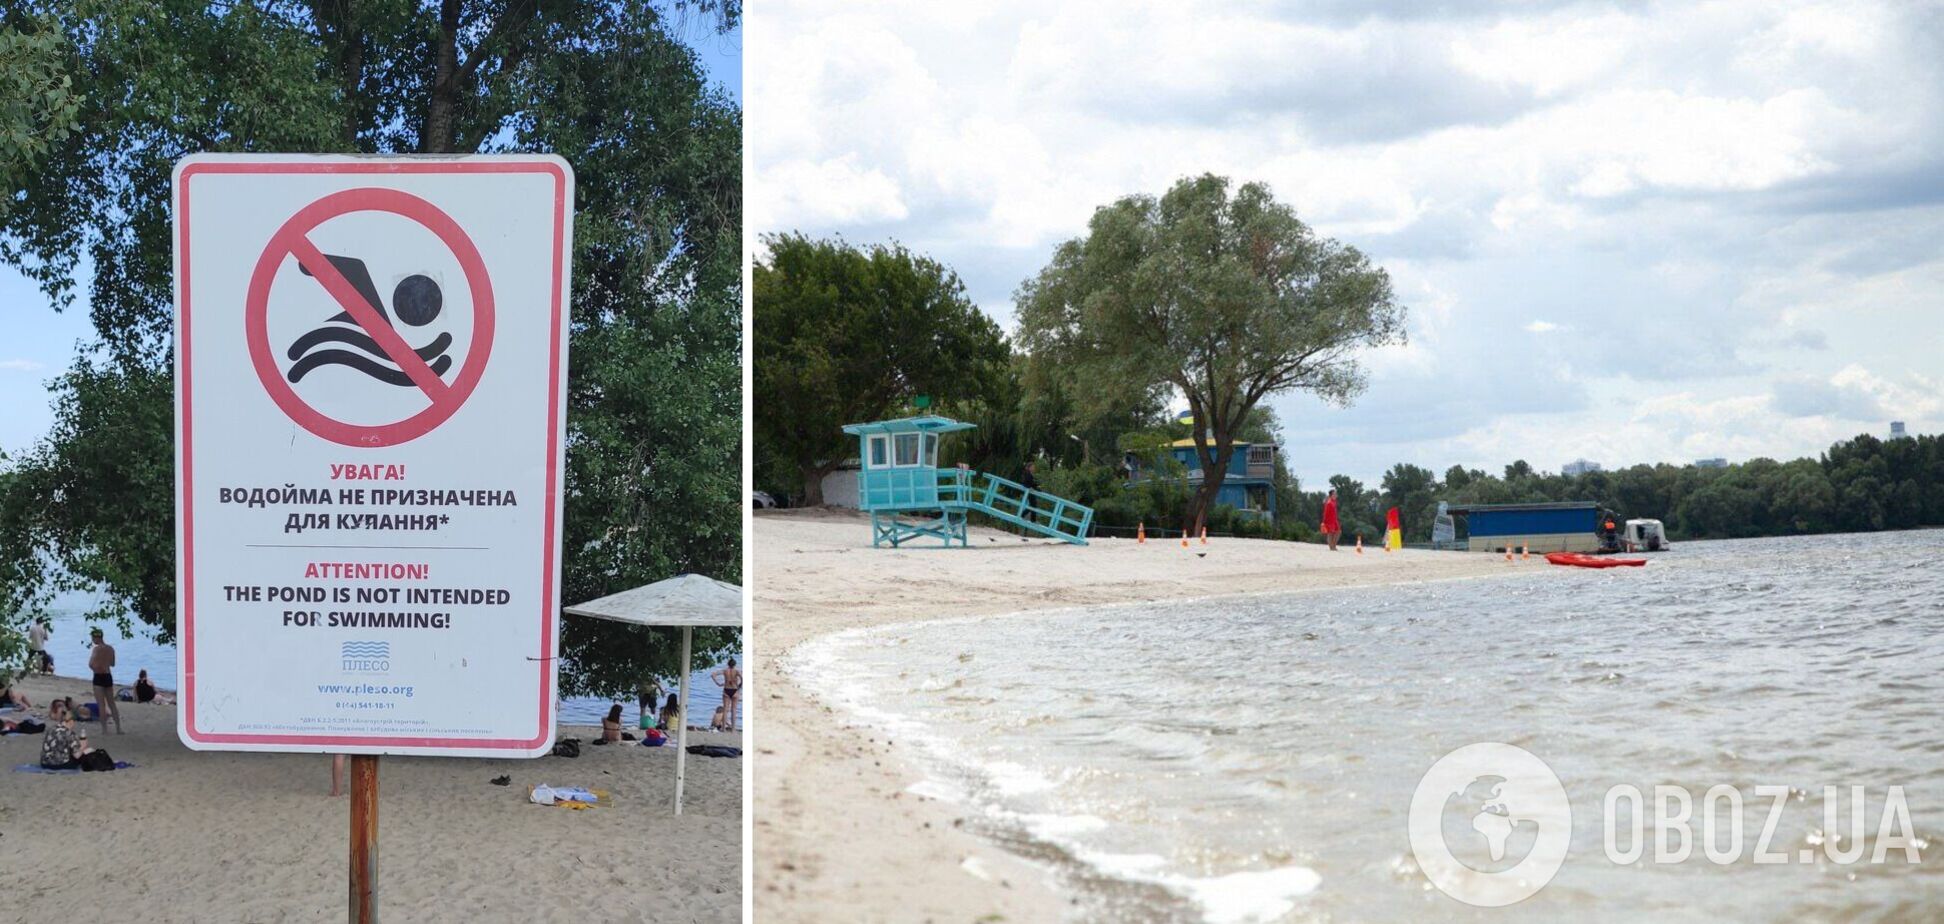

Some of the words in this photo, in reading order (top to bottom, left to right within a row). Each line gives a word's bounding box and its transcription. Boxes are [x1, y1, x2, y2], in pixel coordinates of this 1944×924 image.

[330, 464, 405, 480] УВАГА!
[219, 484, 333, 508] ВОДОЙМА
[339, 489, 365, 505] НЕ
[371, 489, 517, 506] ПРИЗНАЧЕНА
[284, 513, 330, 533] ДЛЯ
[304, 562, 429, 580] ATTENTION!
[223, 585, 261, 602] THE
[268, 586, 326, 603] POND
[333, 587, 351, 604] IS
[356, 588, 400, 604] NOT
[406, 588, 511, 605] INTENDED
[328, 612, 450, 629] SWIMMING!
[342, 659, 390, 672] ПЛЕСО
[317, 683, 414, 698] www.pleso.org
